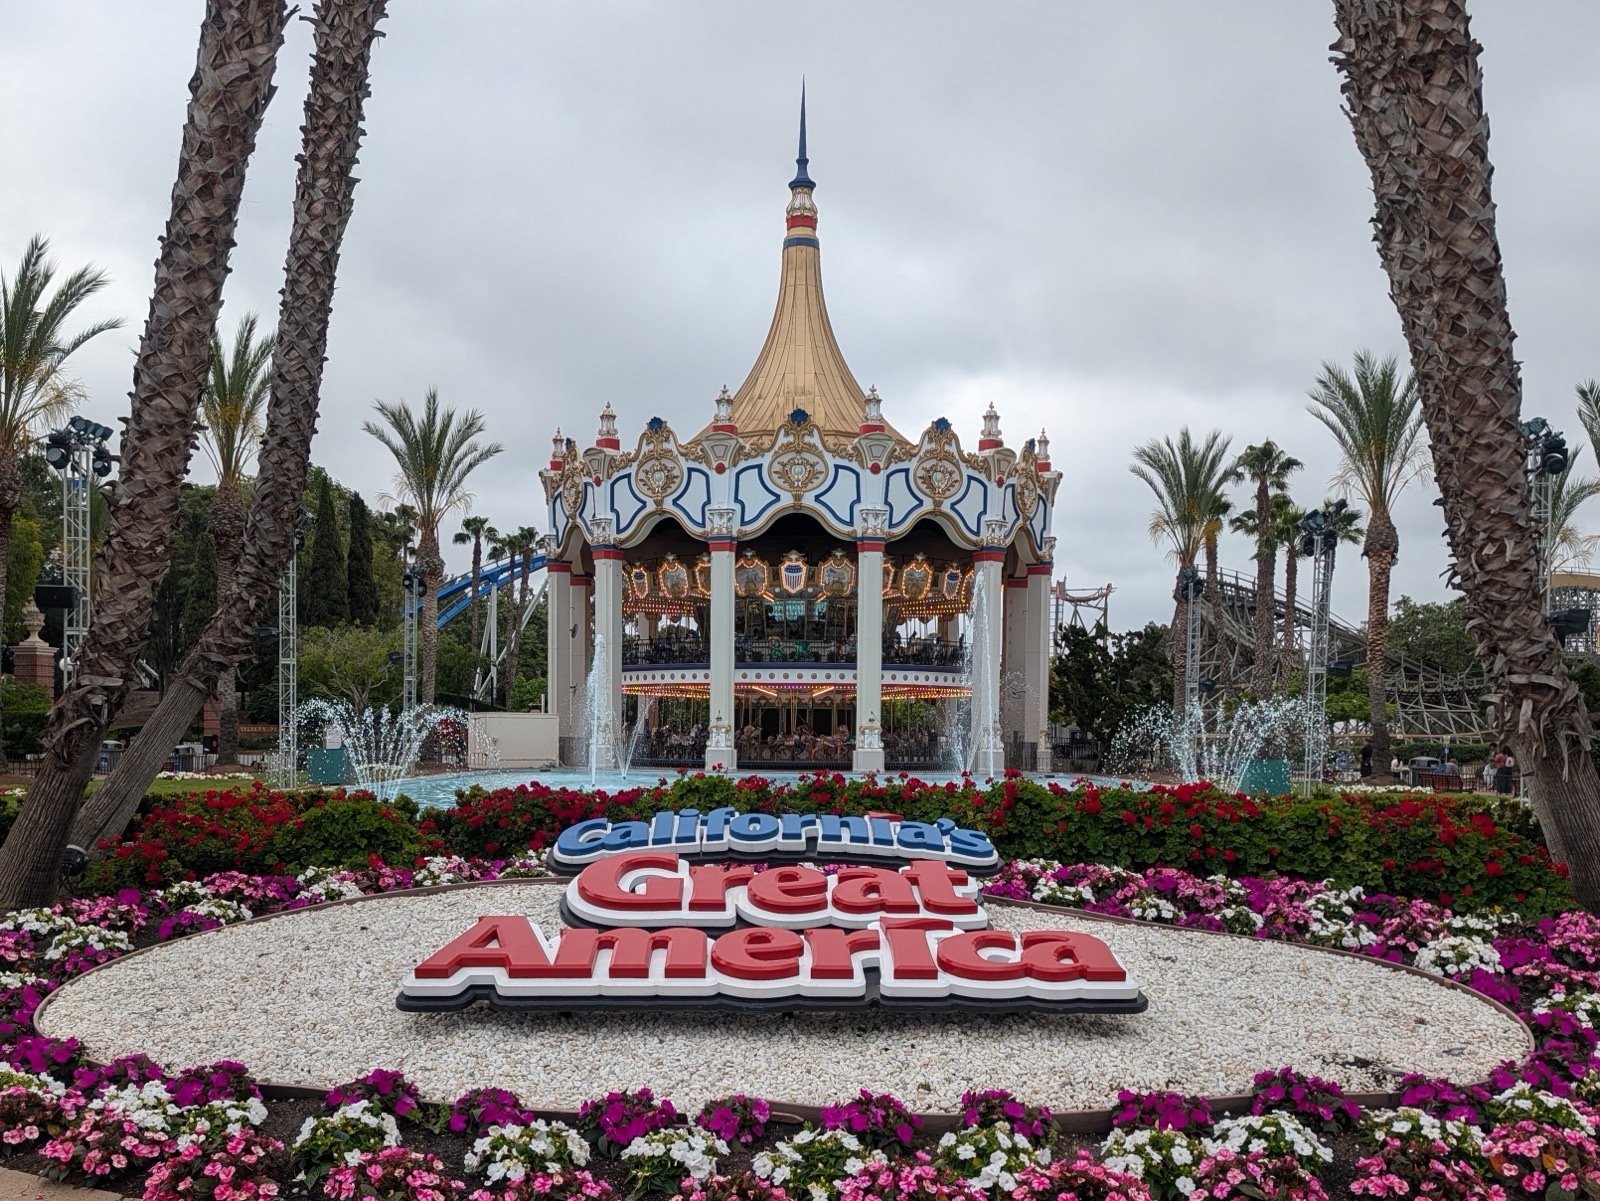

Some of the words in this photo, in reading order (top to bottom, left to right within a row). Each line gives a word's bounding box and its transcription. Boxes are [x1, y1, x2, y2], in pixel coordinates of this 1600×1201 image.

[556, 807, 996, 859] California's
[576, 852, 980, 914] Great
[413, 915, 1128, 980] America
